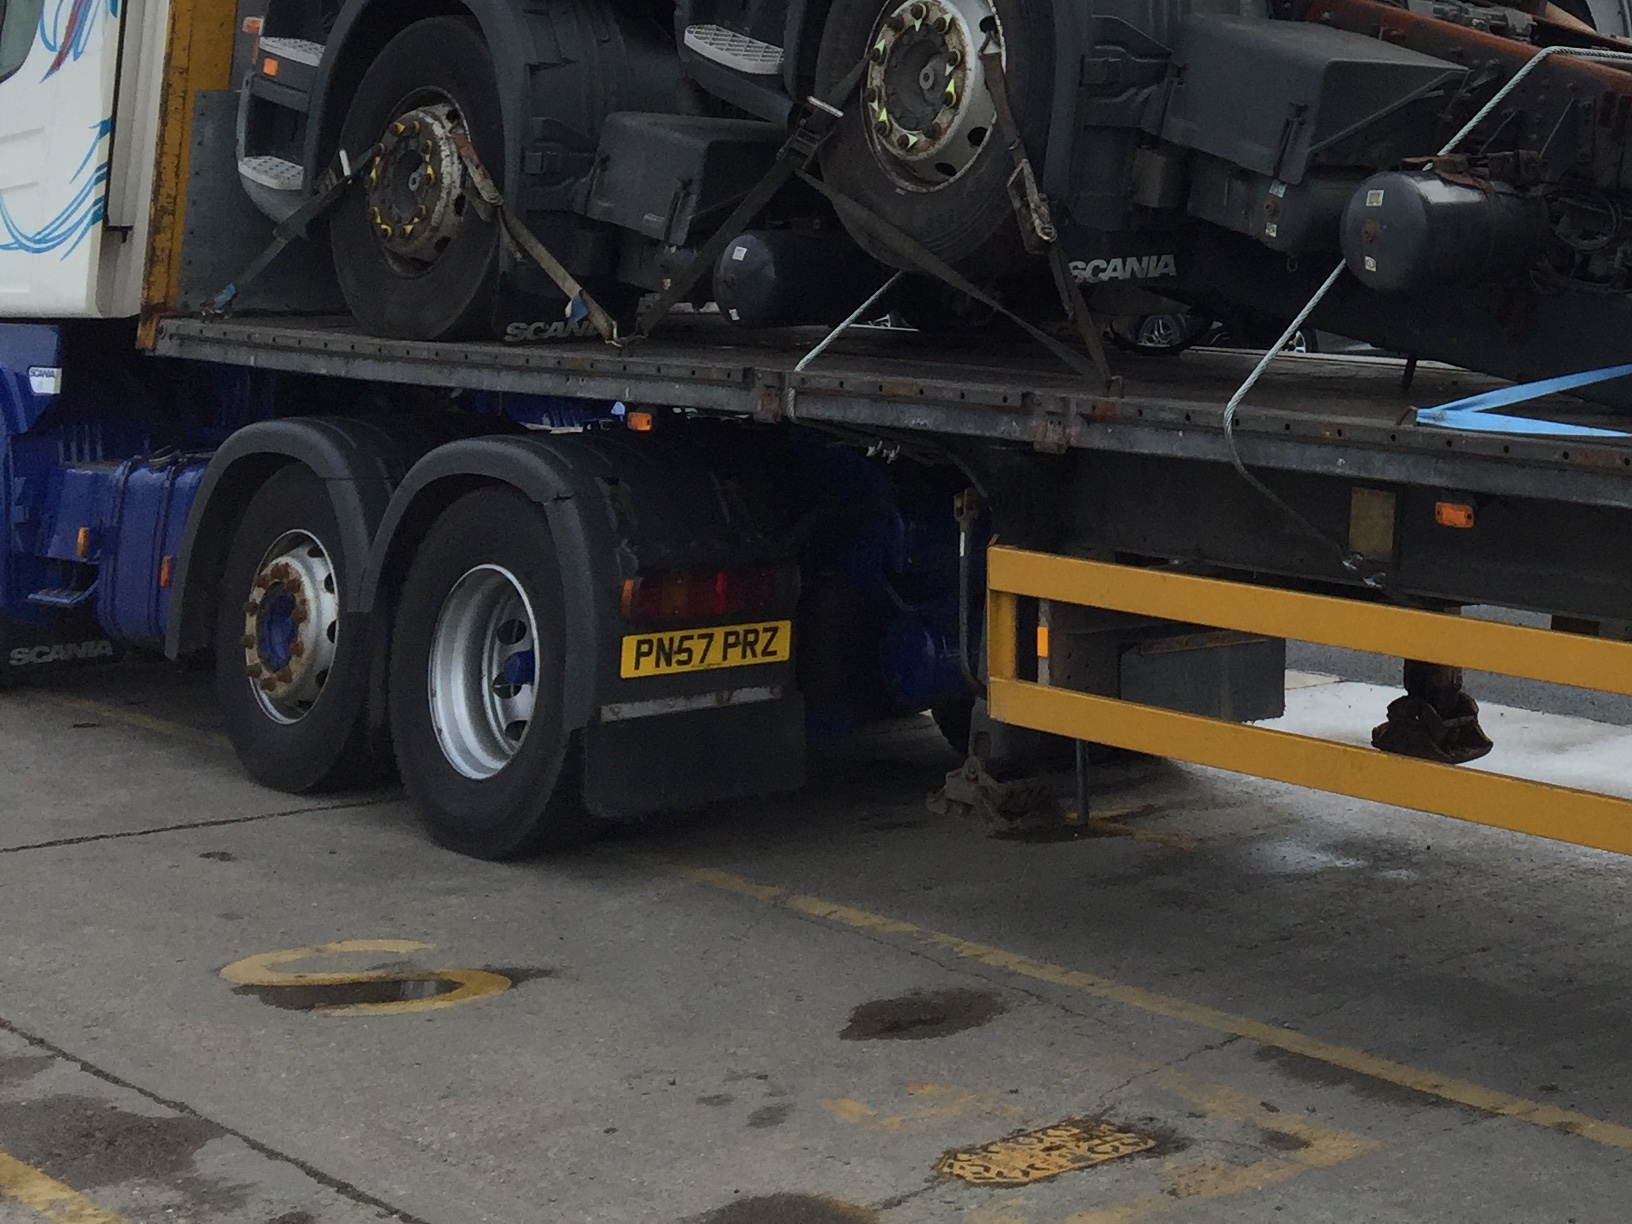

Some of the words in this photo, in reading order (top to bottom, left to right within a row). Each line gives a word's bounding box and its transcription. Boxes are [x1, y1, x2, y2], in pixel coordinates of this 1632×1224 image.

[1068, 255, 1176, 283] SCANIA
[504, 321, 604, 342] SCANI
[9, 640, 113, 666] SCANIA
[634, 633, 714, 670] PN57
[722, 626, 780, 662] PRZ
